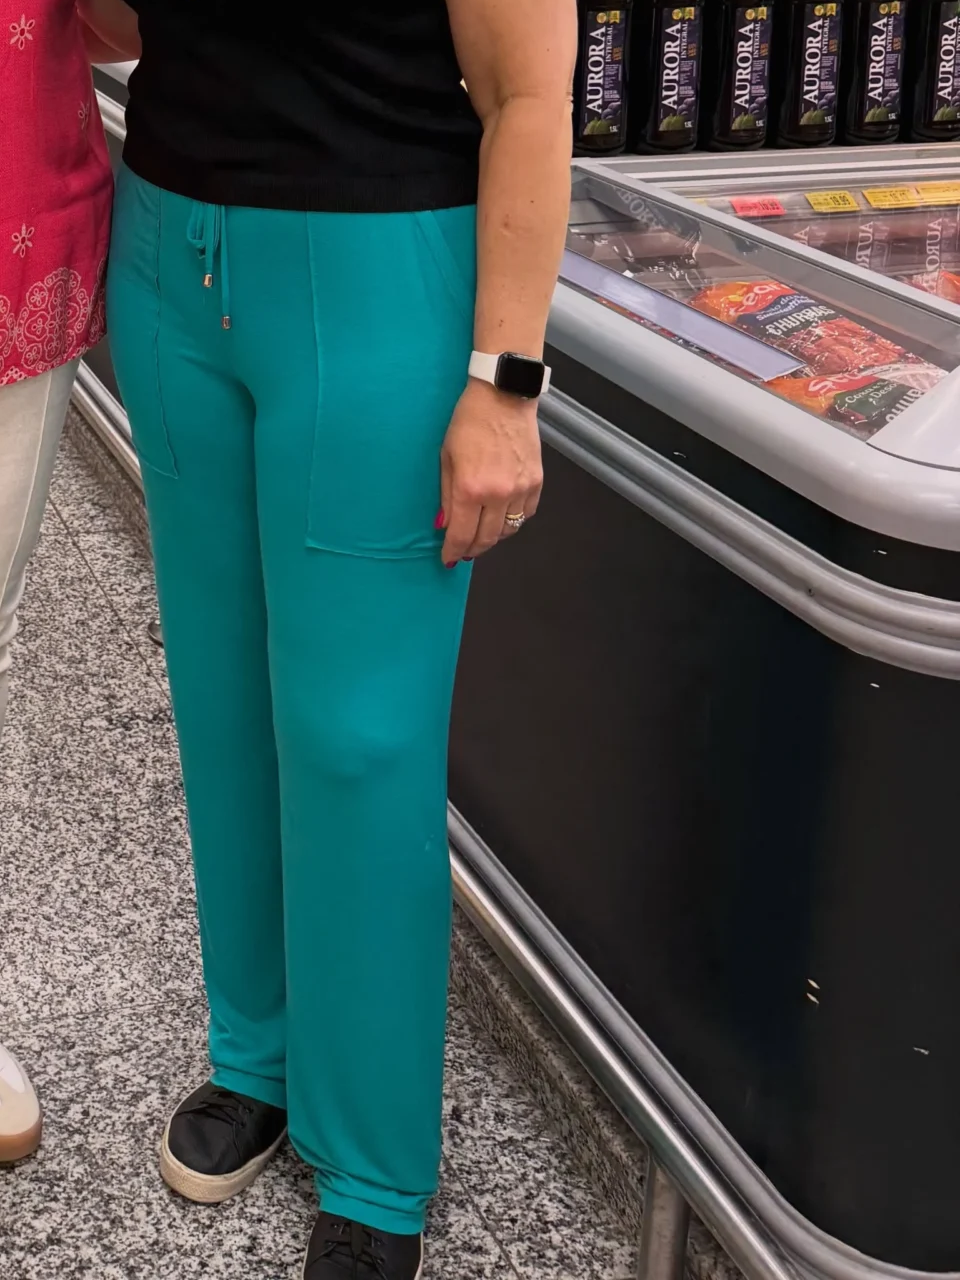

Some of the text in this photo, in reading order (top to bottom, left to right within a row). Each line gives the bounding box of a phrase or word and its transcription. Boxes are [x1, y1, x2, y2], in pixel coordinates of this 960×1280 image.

[586, 25, 607, 114] AURORA
[661, 22, 681, 109] AURORA
[734, 22, 755, 108] AURORA
[803, 18, 823, 105] AURORA
[868, 16, 888, 102] AURORA
[938, 16, 959, 101] AURORA
